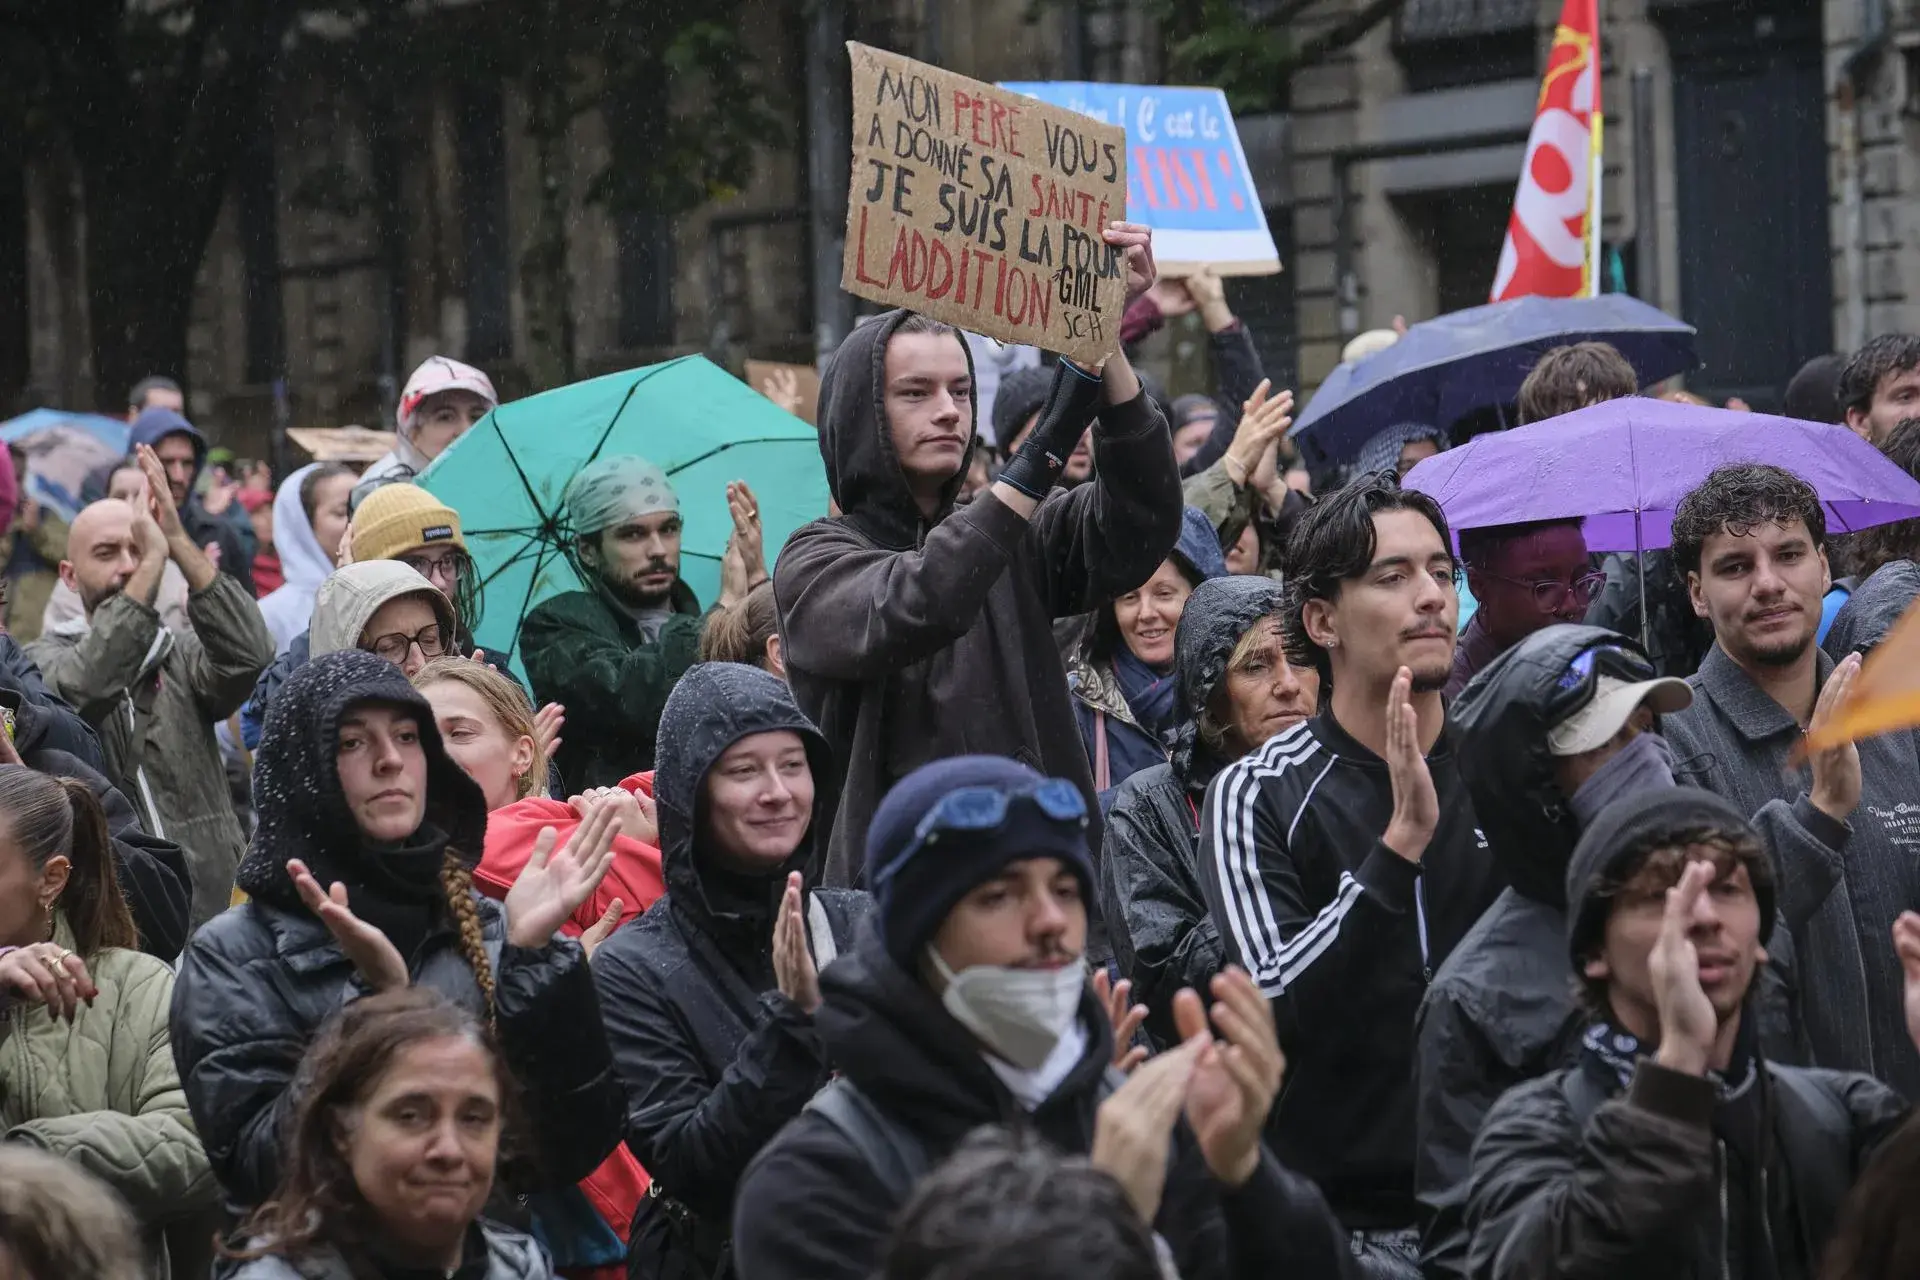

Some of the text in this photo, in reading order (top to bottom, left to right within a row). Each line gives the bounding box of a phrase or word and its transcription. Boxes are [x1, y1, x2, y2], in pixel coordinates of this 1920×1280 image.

[867, 112, 886, 150] A
[894, 120, 975, 190] DONNÉ
[979, 155, 1014, 208] SA
[1029, 173, 1111, 235] SANTÉ
[876, 66, 940, 131] MON
[1043, 118, 1118, 184] VOUS
[866, 158, 1123, 280] JE SUIS LA POUR
